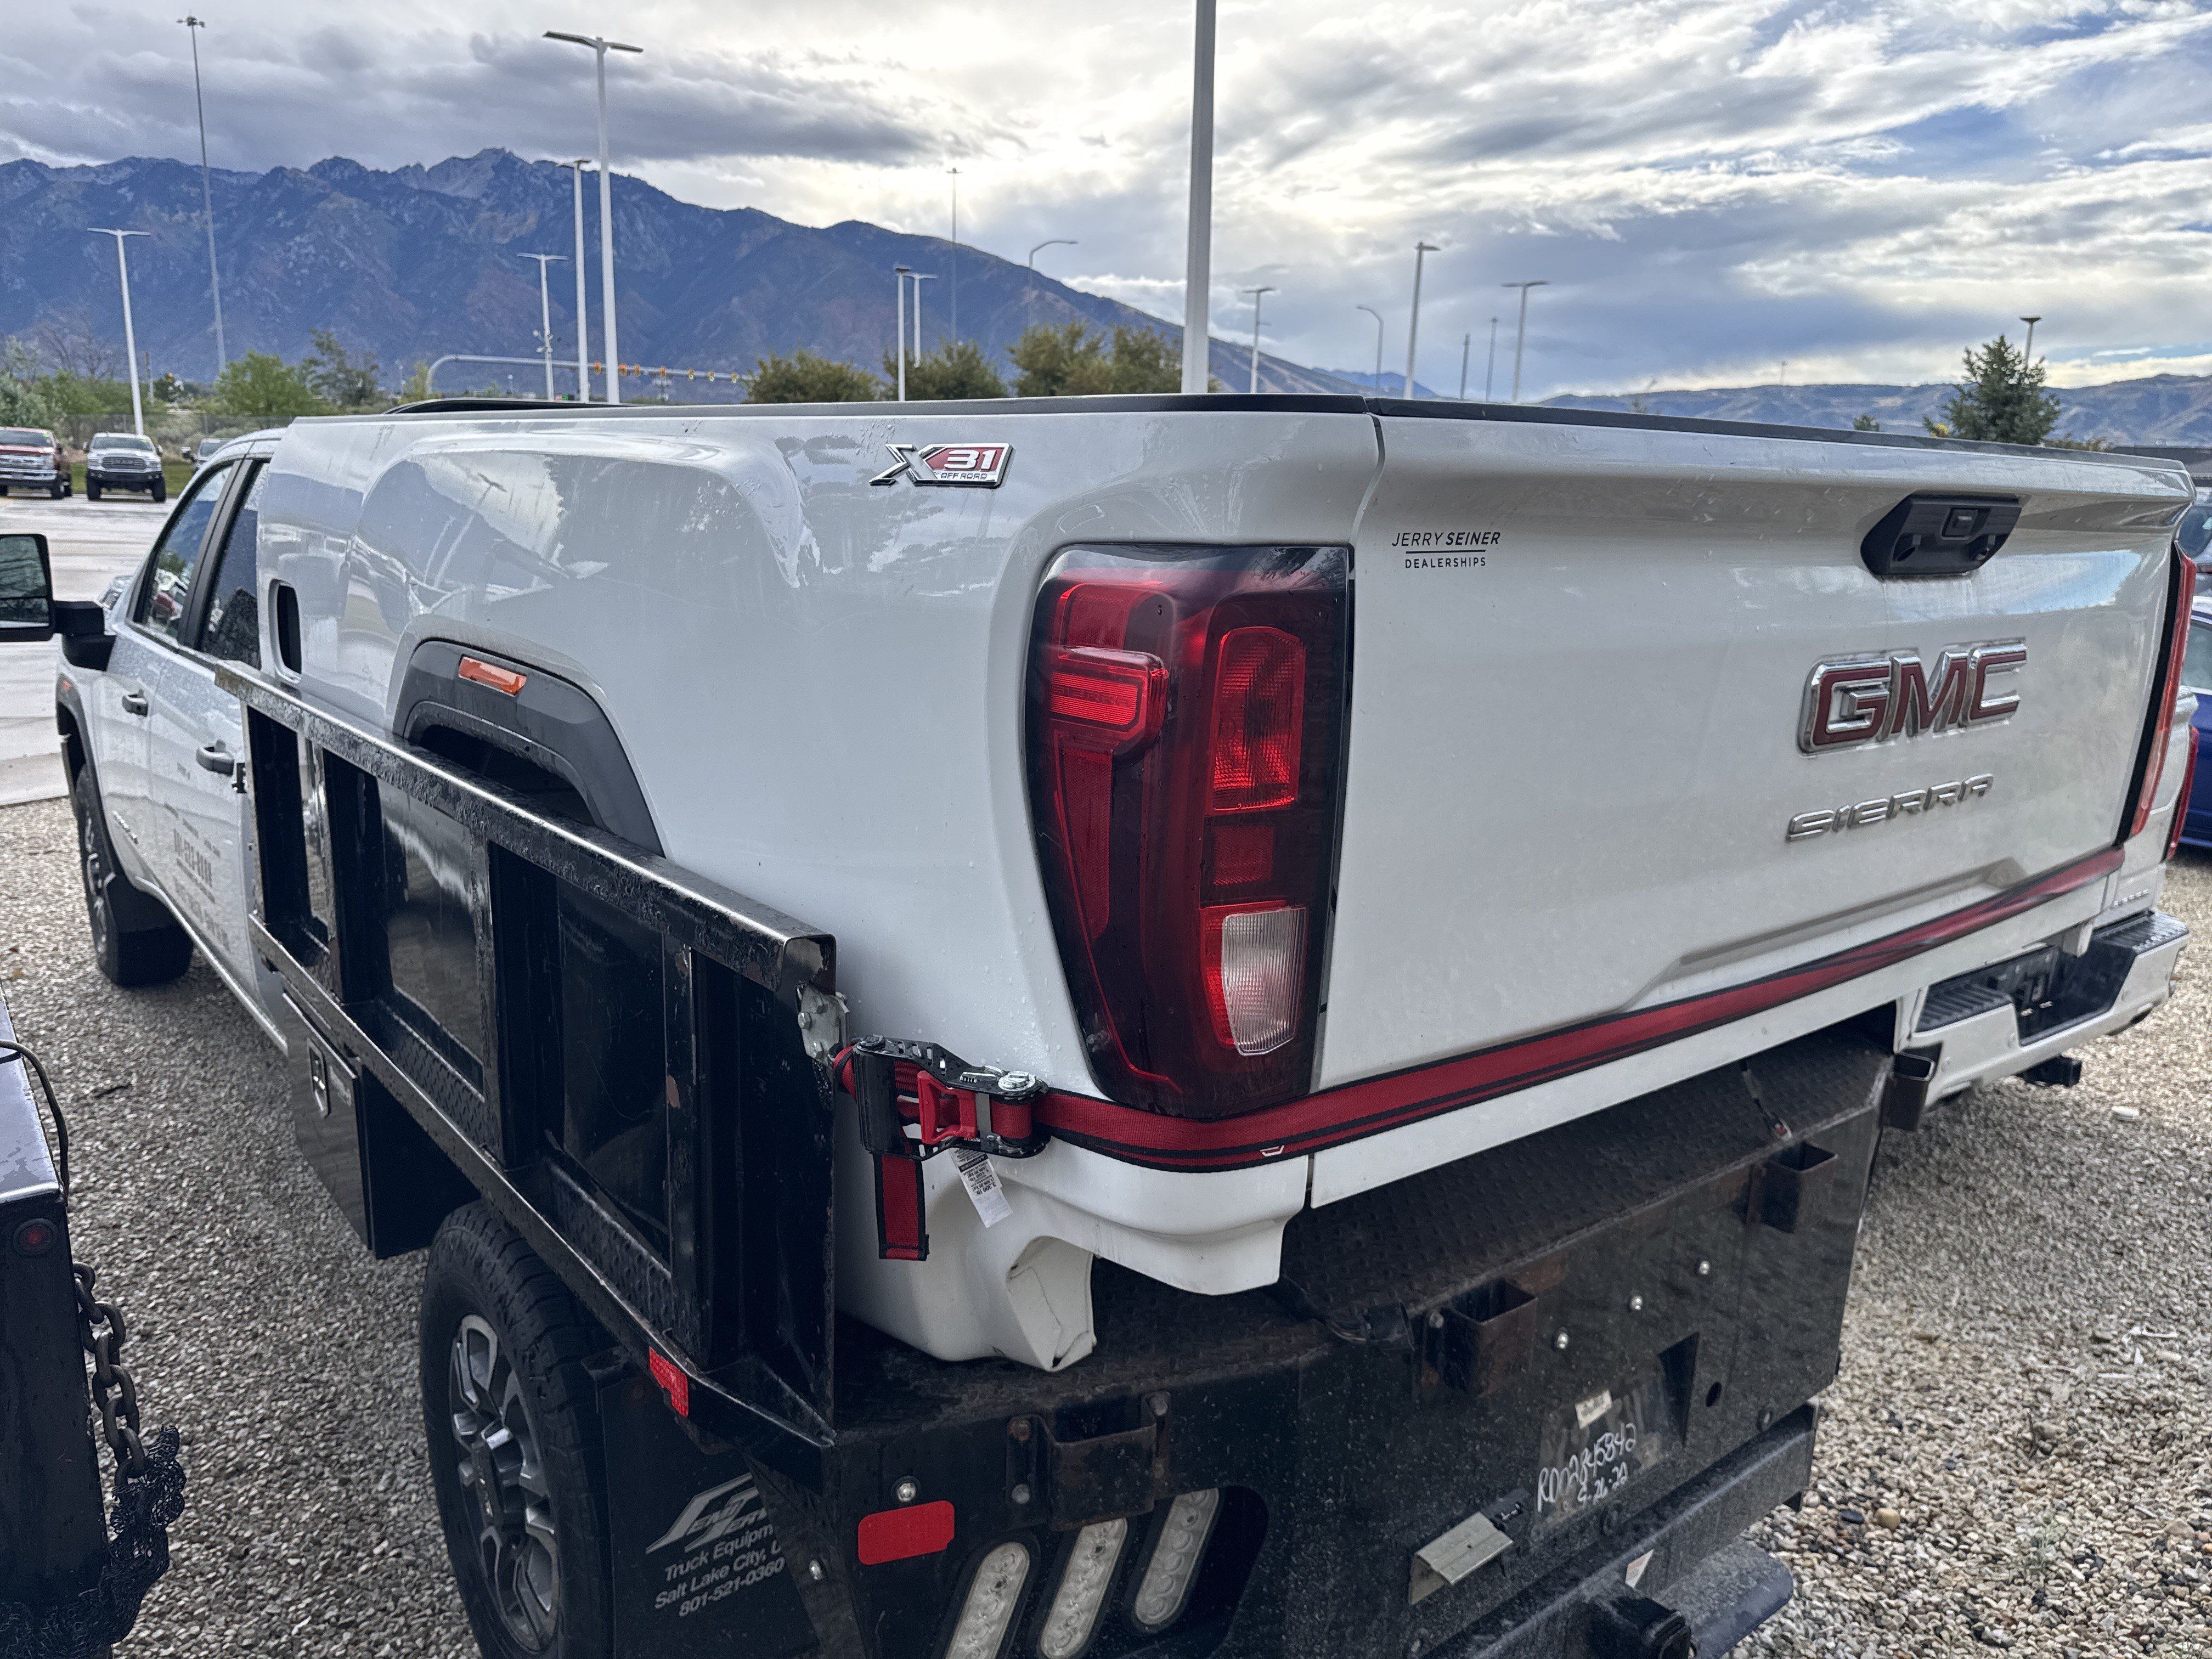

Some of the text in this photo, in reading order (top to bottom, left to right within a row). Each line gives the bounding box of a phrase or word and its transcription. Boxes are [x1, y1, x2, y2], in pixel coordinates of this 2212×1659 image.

[1392, 532, 1501, 547] JERRY SEINER
[1405, 557, 1486, 569] DEALERSHIPS
[1051, 685, 1132, 708] SIERRA
[1796, 642, 2027, 754] GMC
[1785, 772, 1994, 842] SIERRA
[655, 1583, 687, 1609] Salt
[690, 1564, 730, 1592] Lake
[733, 1548, 767, 1572] City,
[665, 1523, 774, 1582] Truck Equipm
[679, 1556, 785, 1617] 801-521-0360
